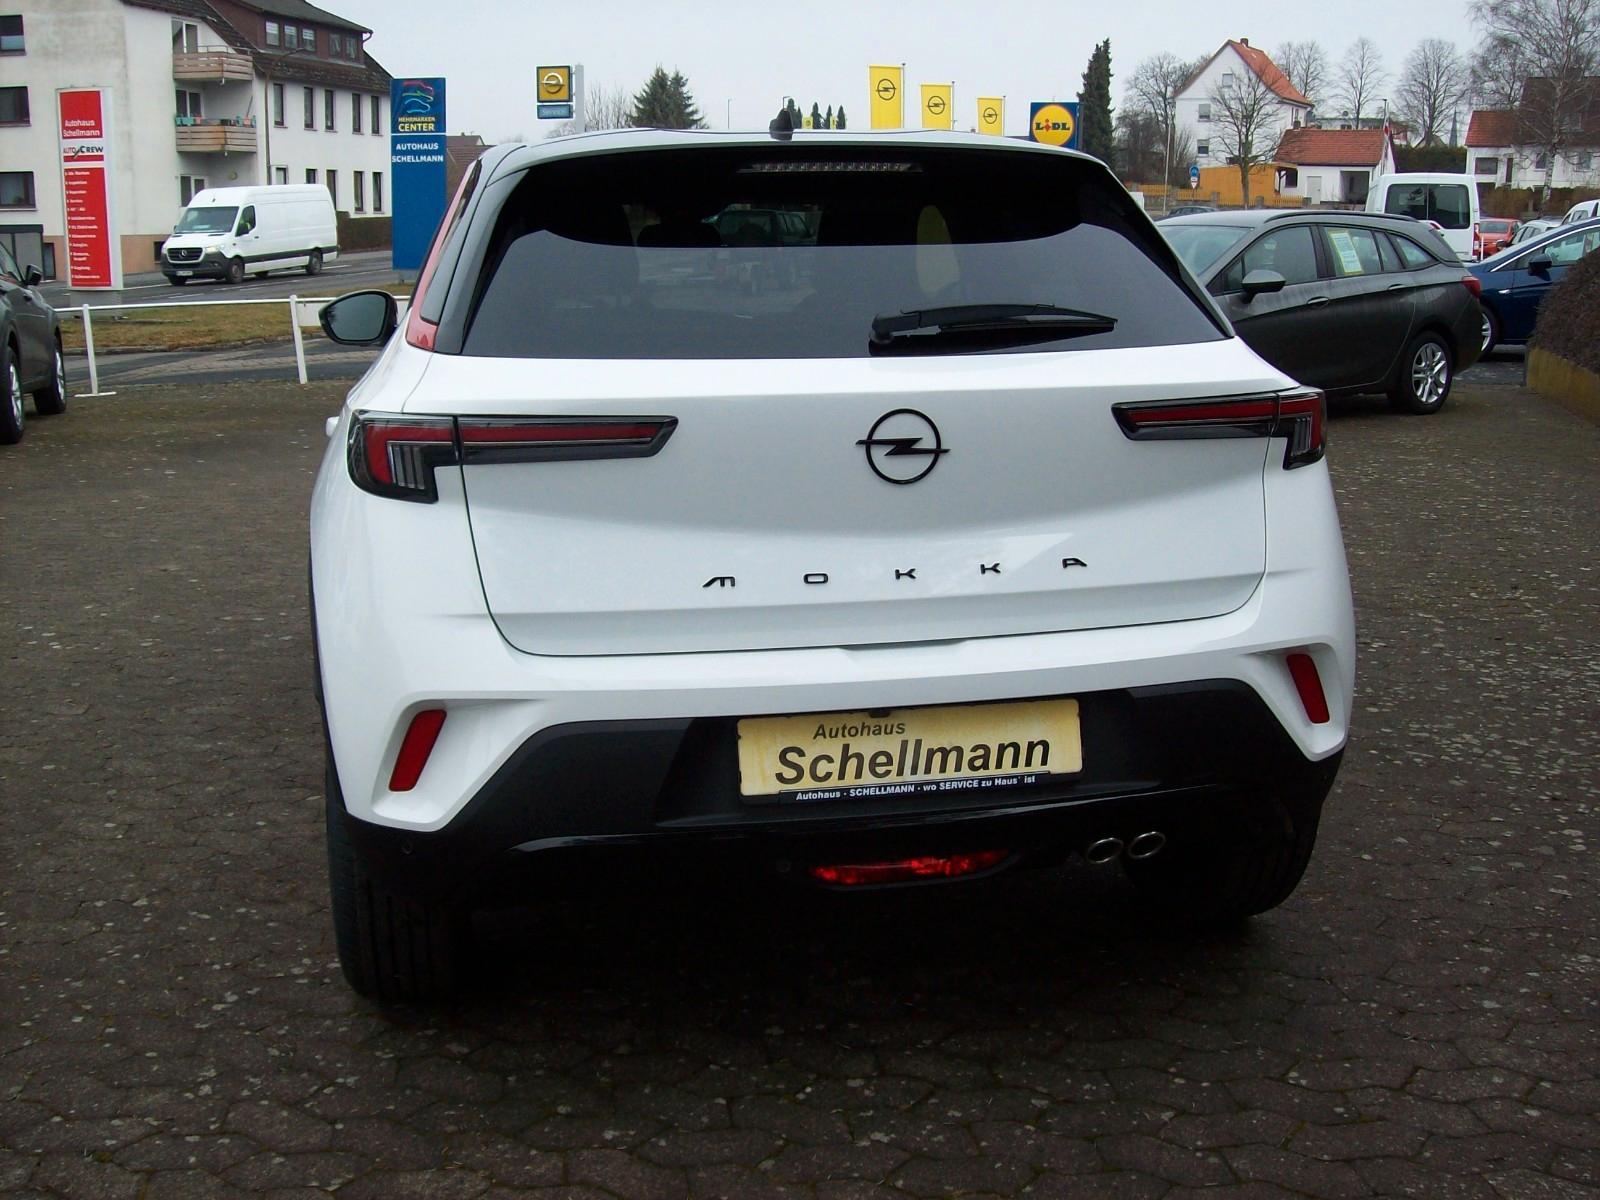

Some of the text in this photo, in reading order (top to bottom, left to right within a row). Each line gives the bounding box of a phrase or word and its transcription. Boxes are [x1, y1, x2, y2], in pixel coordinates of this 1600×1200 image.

[398, 123, 436, 132] CENTER
[395, 142, 439, 150] AUTOHAUS
[391, 154, 444, 163] SCHELLMANN
[813, 721, 906, 740] Autohaus
[775, 738, 1050, 785] Schellmann
[796, 790, 841, 801] Autohaus
[849, 784, 915, 797] SCHELLMANN
[938, 779, 979, 791] SERVICE
[1024, 775, 1036, 784] ist
